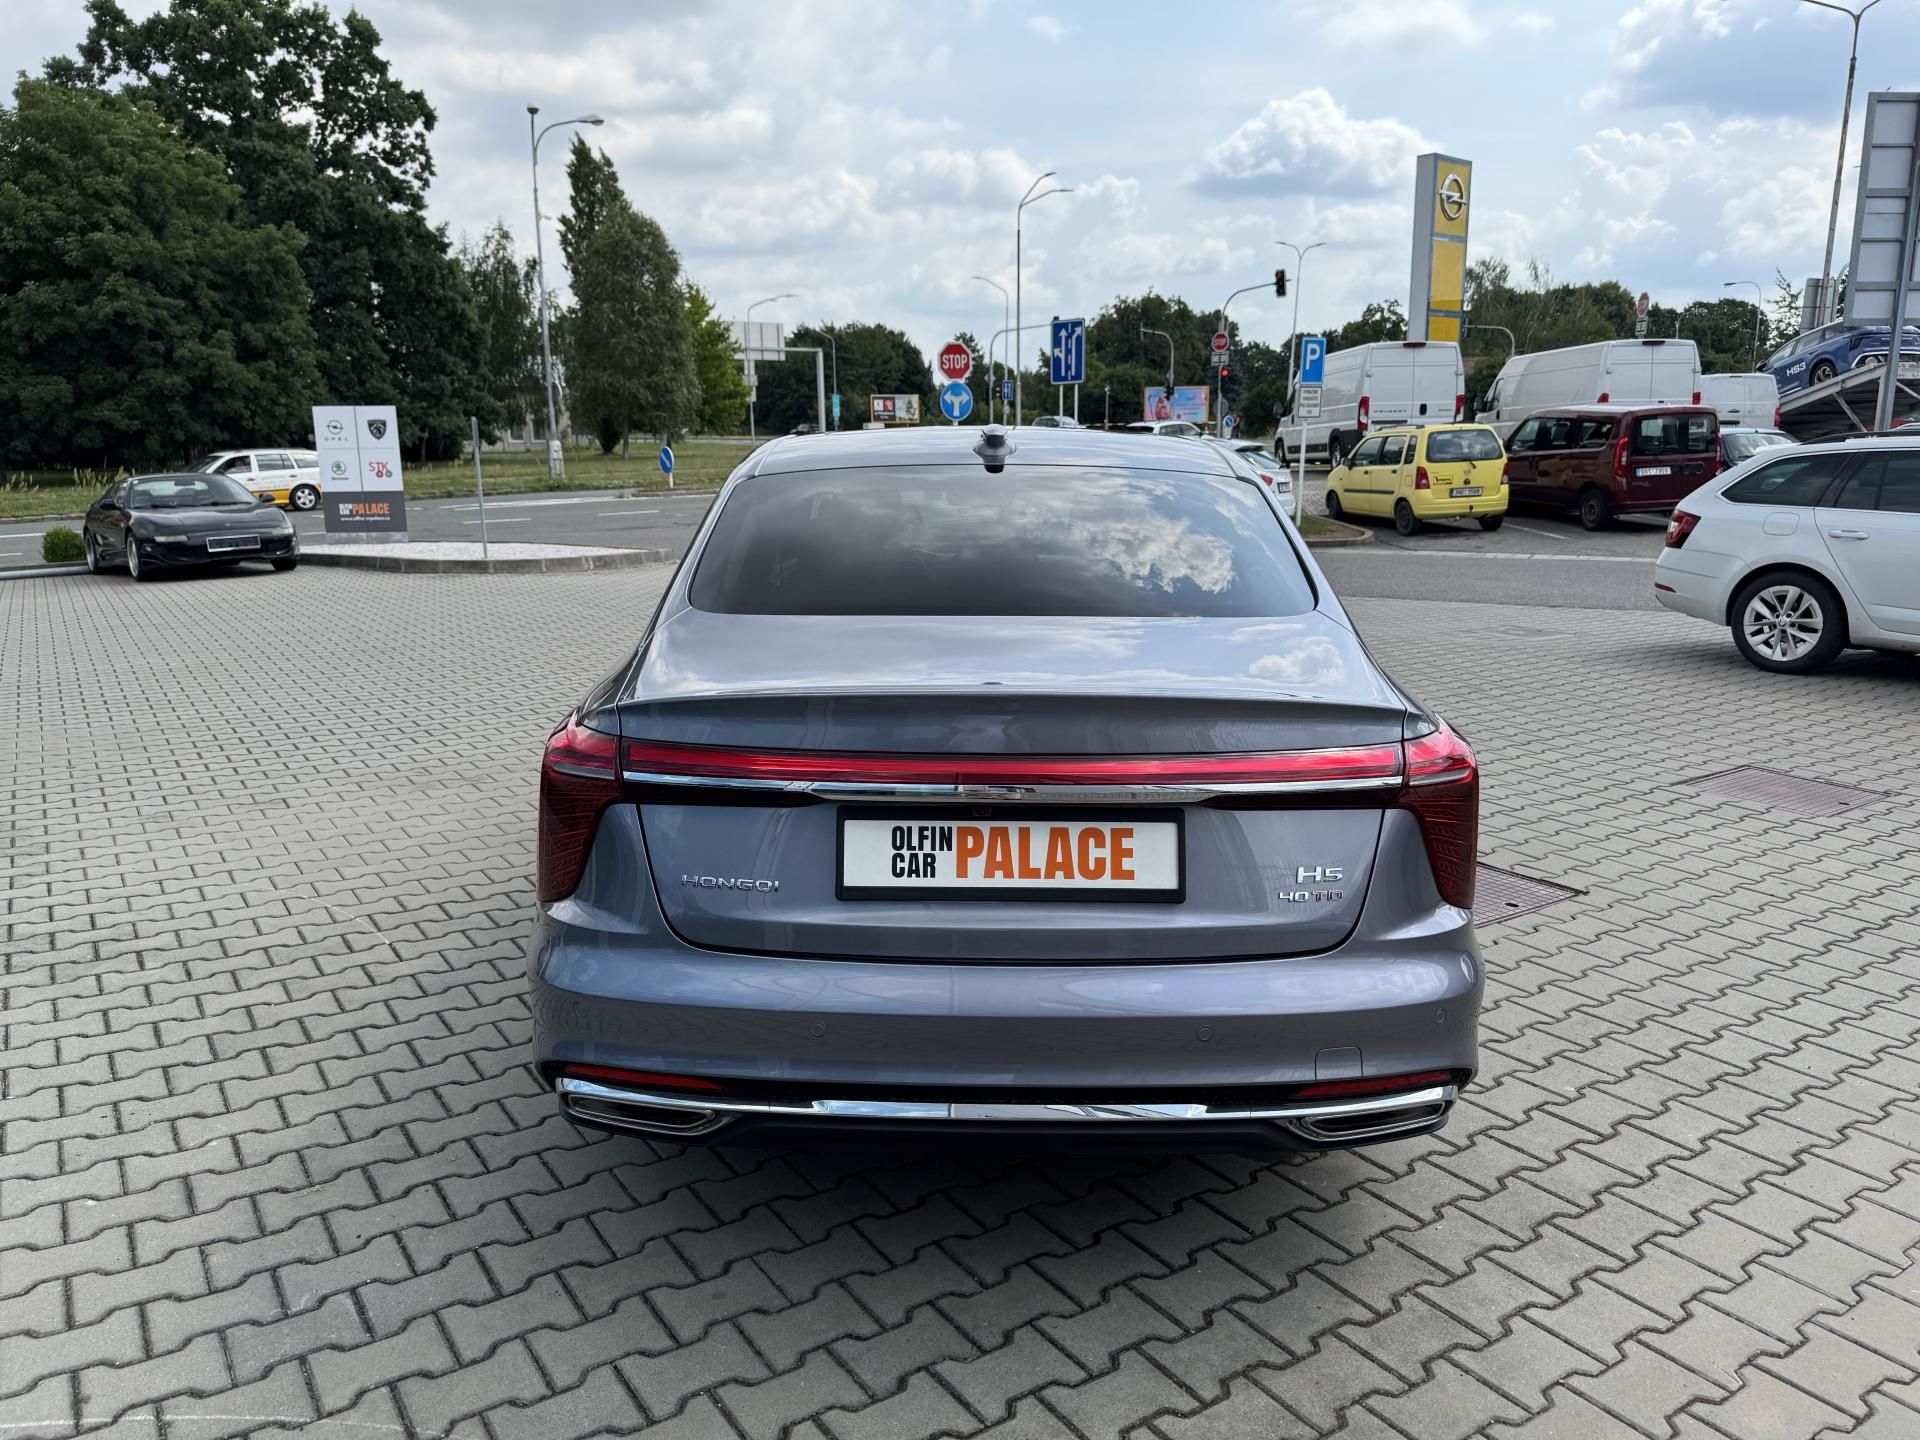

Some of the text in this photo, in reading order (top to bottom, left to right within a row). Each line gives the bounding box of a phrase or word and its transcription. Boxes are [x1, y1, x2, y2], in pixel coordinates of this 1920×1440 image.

[942, 354, 968, 369] STOP
[1305, 343, 1320, 370] P
[1786, 362, 1806, 377] HS3
[352, 502, 390, 515] PALACE
[891, 825, 952, 852] OLFIN
[955, 825, 1135, 881] PALACE
[891, 852, 936, 879] CAR
[1296, 866, 1344, 884] H5
